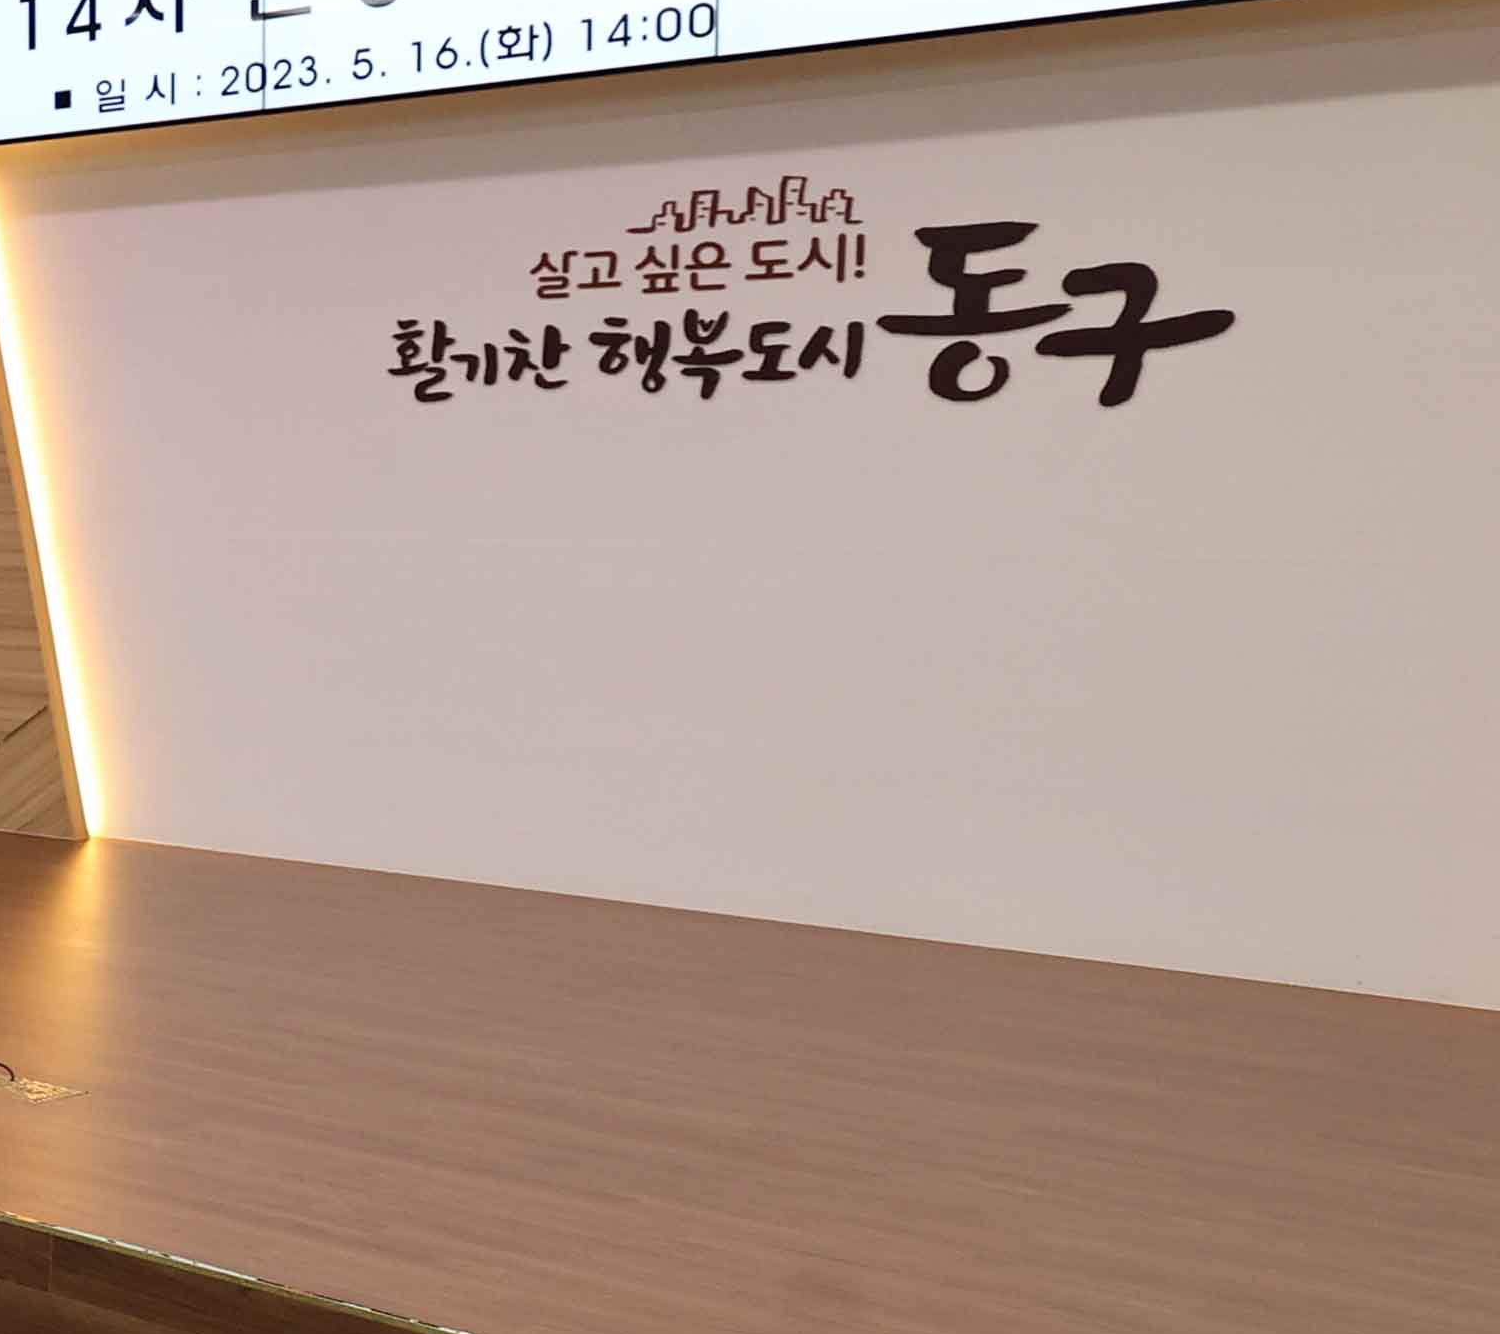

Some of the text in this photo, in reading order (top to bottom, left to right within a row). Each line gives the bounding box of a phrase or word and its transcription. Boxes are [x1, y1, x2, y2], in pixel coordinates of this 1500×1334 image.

[222, 56, 330, 96] 2023.
[353, 49, 385, 79] 5.
[582, 3, 716, 51] 14:00
[530, 234, 864, 299] 살고 싶은 도시!
[388, 222, 1235, 407] 활기찬 행복도시 동구
